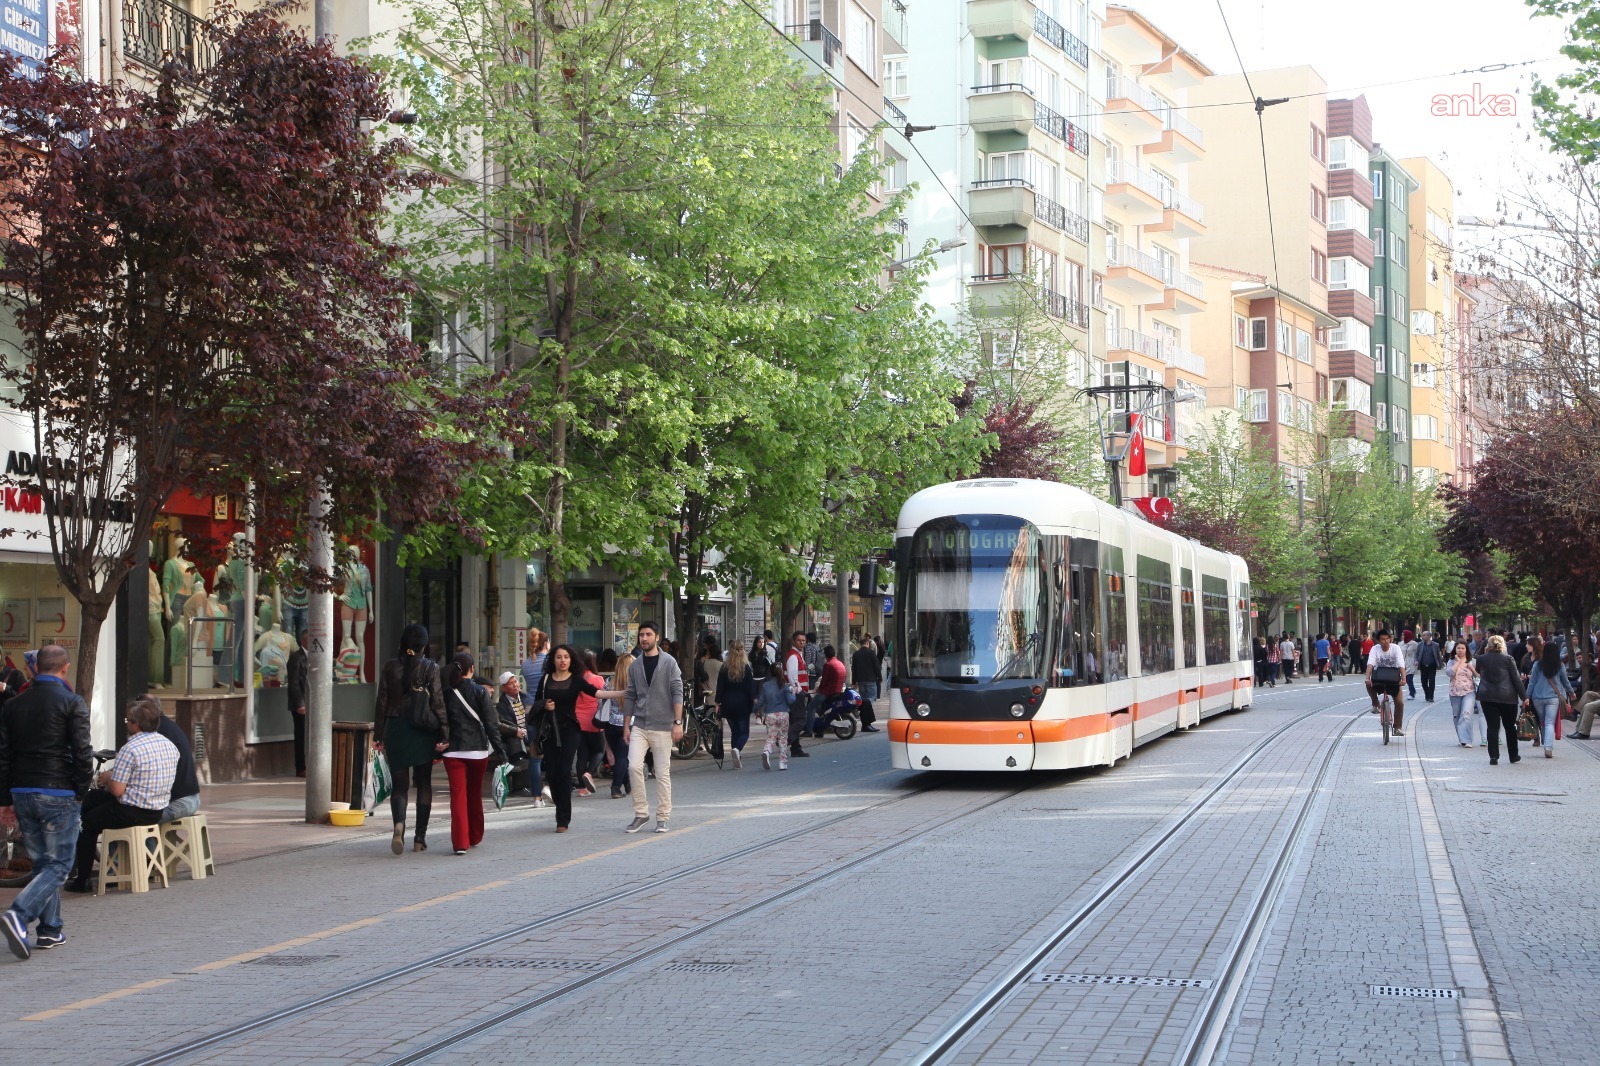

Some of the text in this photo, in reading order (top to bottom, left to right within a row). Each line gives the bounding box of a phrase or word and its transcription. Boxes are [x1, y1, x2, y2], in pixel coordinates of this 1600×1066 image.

[0, 28, 47, 64] MERKEZİ
[4, 486, 42, 514] KAN
[945, 532, 1017, 549] OTOGAR
[965, 667, 975, 676] 23
